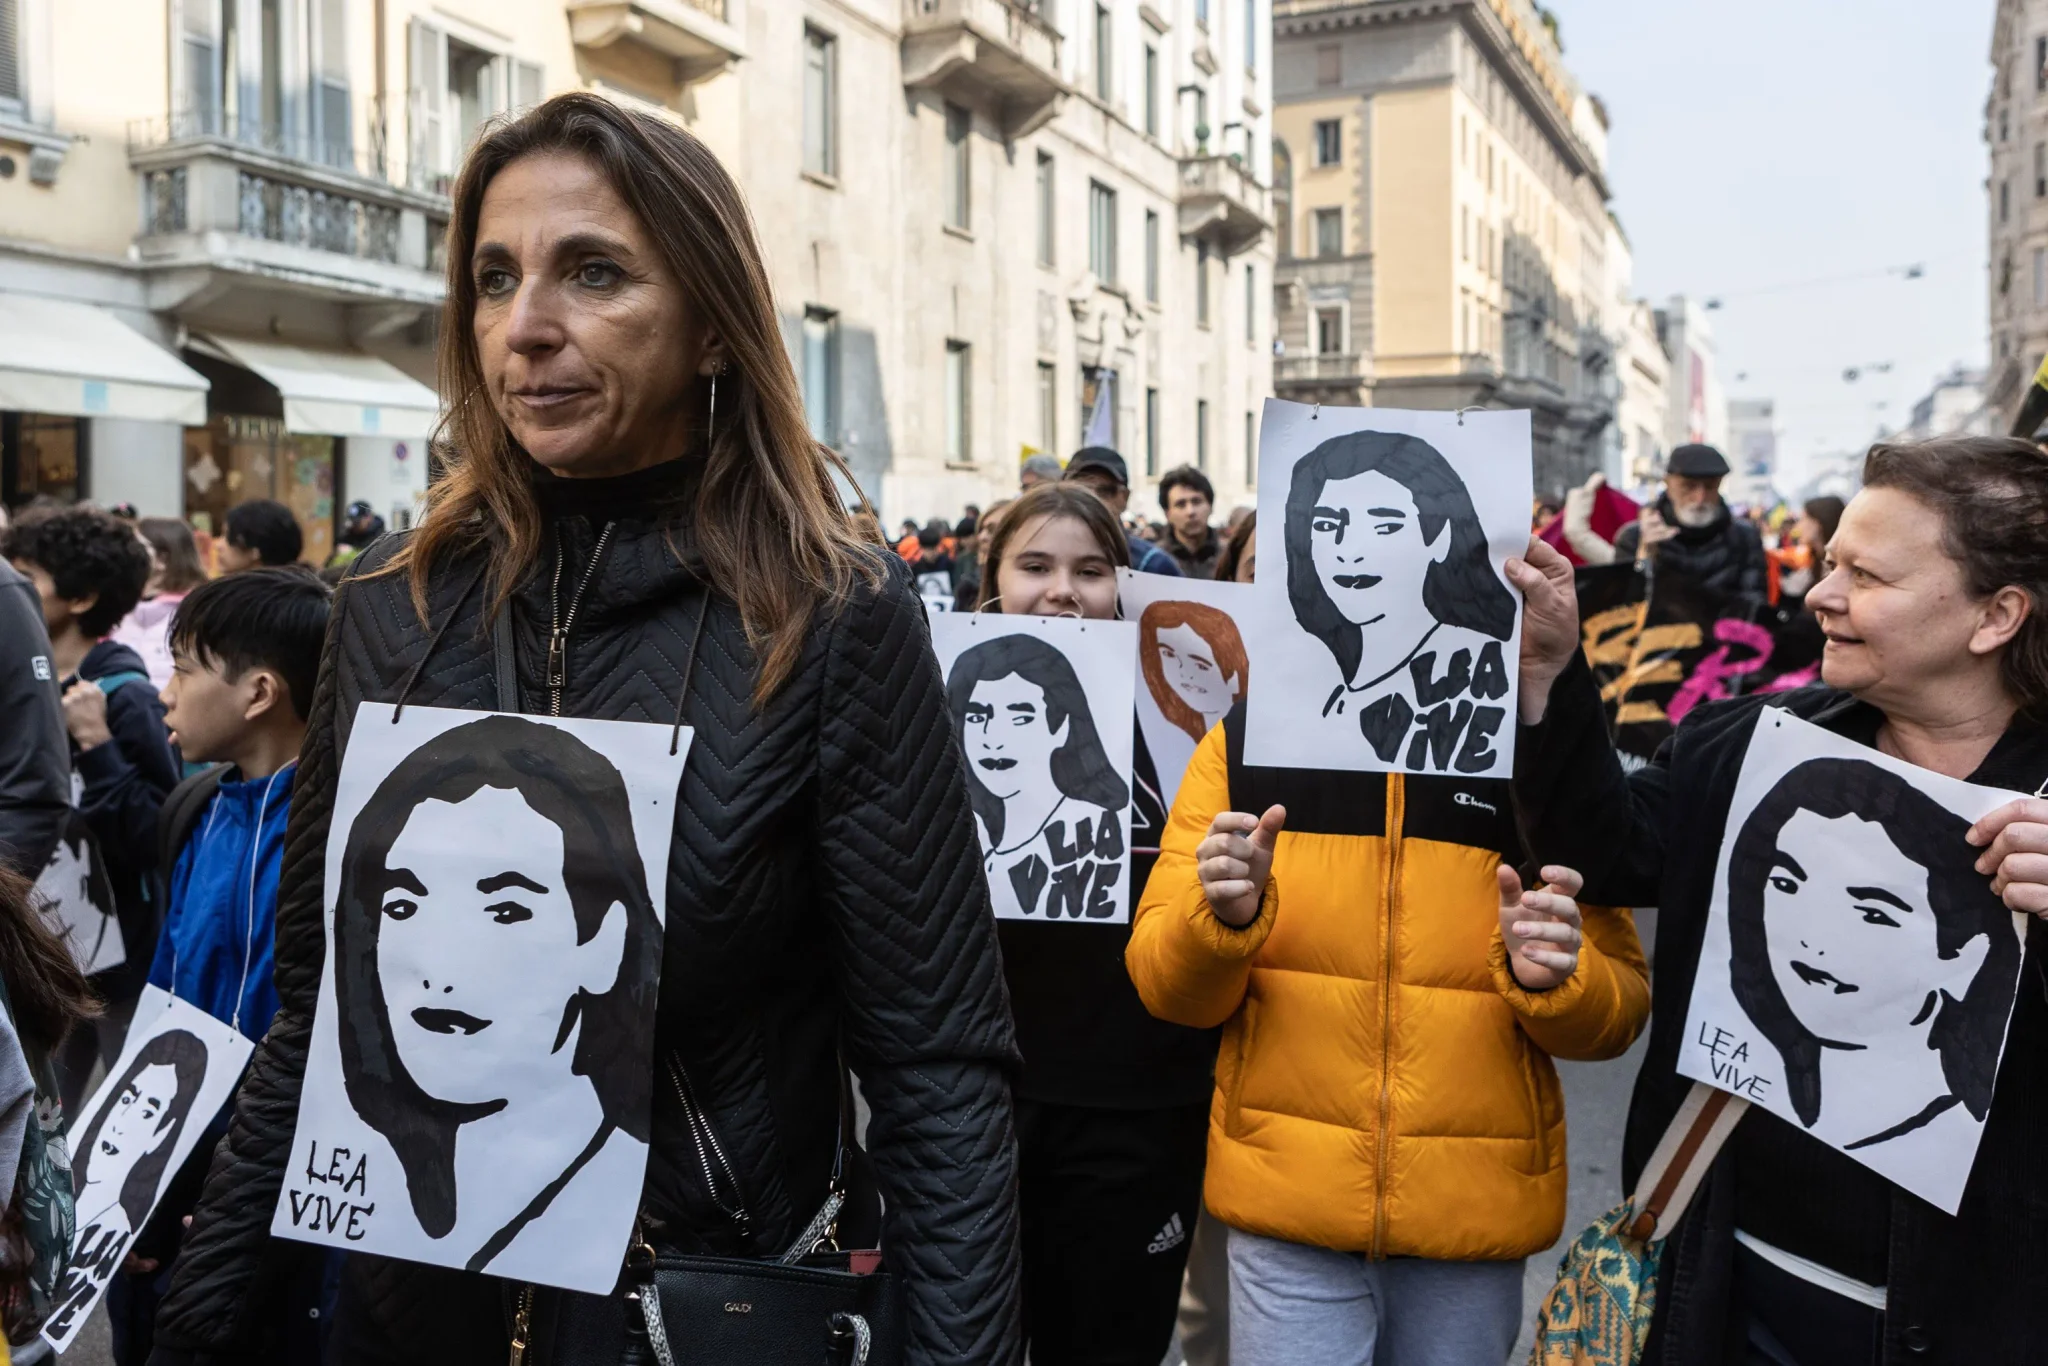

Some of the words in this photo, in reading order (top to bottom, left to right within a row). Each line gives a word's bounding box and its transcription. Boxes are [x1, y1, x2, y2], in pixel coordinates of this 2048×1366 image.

[1409, 641, 1509, 708] LEA
[1043, 809, 1125, 867] LEA
[1699, 1021, 1750, 1063] LEA
[1710, 1056, 1772, 1102] VIVE
[306, 1140, 367, 1197] LEA
[289, 1189, 375, 1241] VIVE
